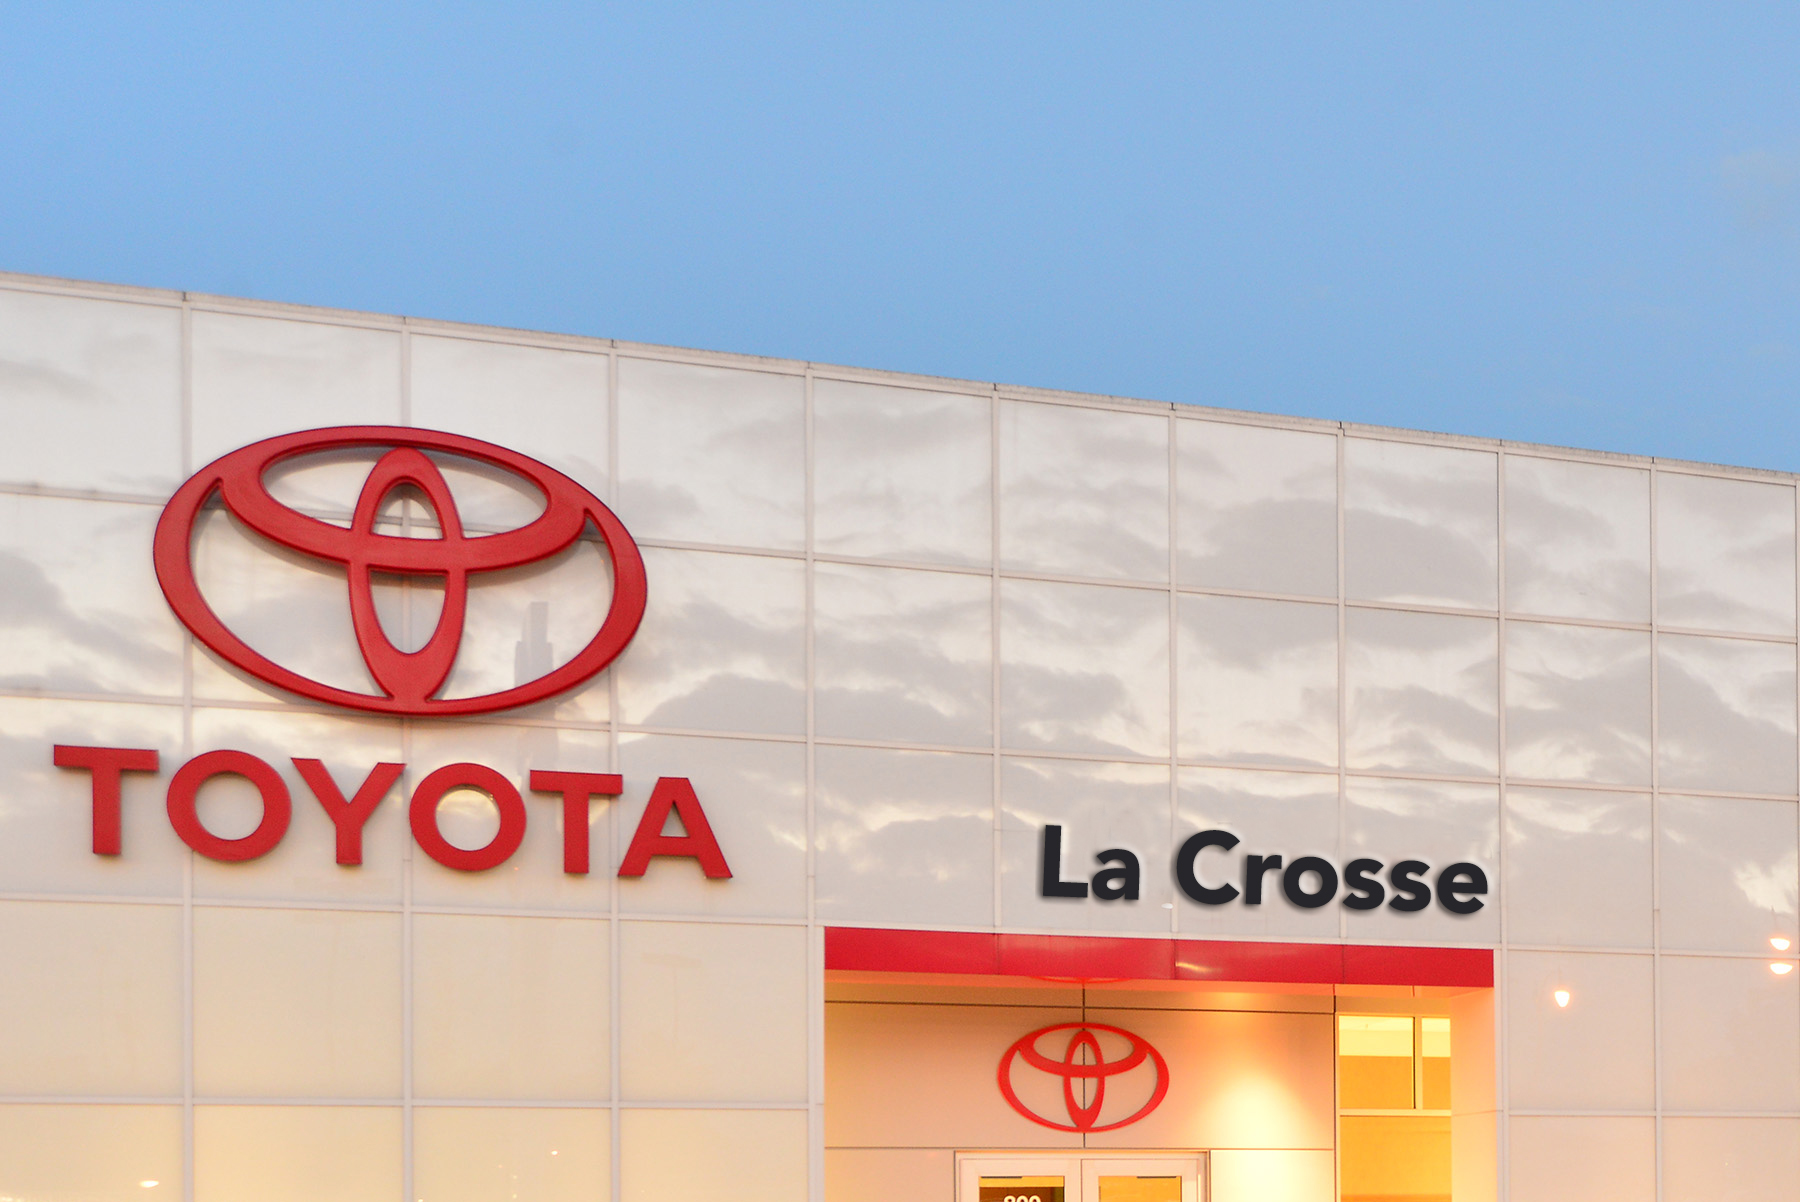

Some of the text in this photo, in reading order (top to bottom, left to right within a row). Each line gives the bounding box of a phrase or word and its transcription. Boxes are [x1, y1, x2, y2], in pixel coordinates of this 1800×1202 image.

[54, 744, 733, 879] TOYOTA
[1042, 824, 1488, 915] La Crosse
